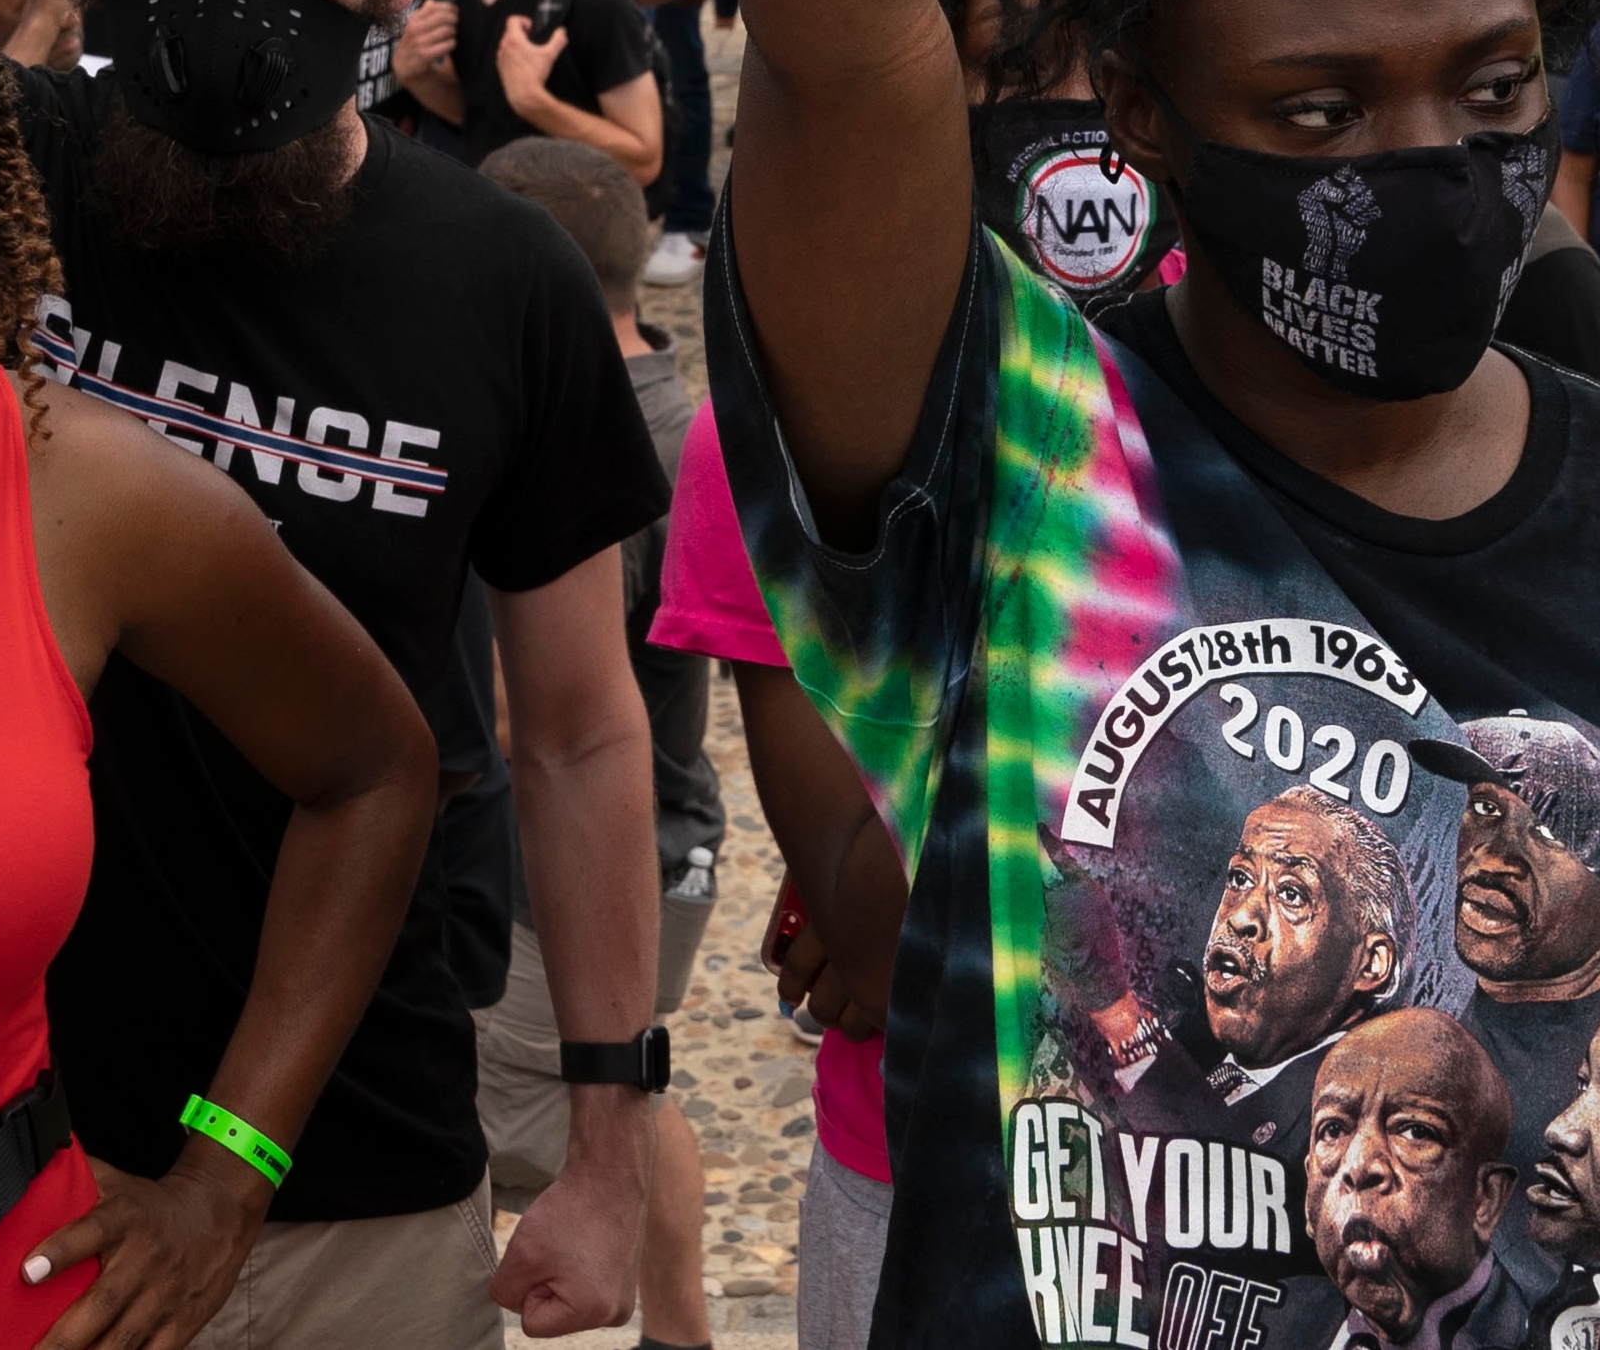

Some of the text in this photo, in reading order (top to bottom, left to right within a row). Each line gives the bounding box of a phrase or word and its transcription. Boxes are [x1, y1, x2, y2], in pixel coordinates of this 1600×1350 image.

[1035, 193, 1138, 244] NAN
[1261, 256, 1383, 325] BLACK
[1261, 285, 1378, 353] LIVES
[1262, 310, 1379, 379] MATTER
[1076, 624, 1417, 829] AUGUST 28th 1963
[1218, 682, 1412, 814] 2020
[1014, 1102, 1291, 1255] GET YOUR
[1016, 1224, 1281, 1350] KNEE OFF
